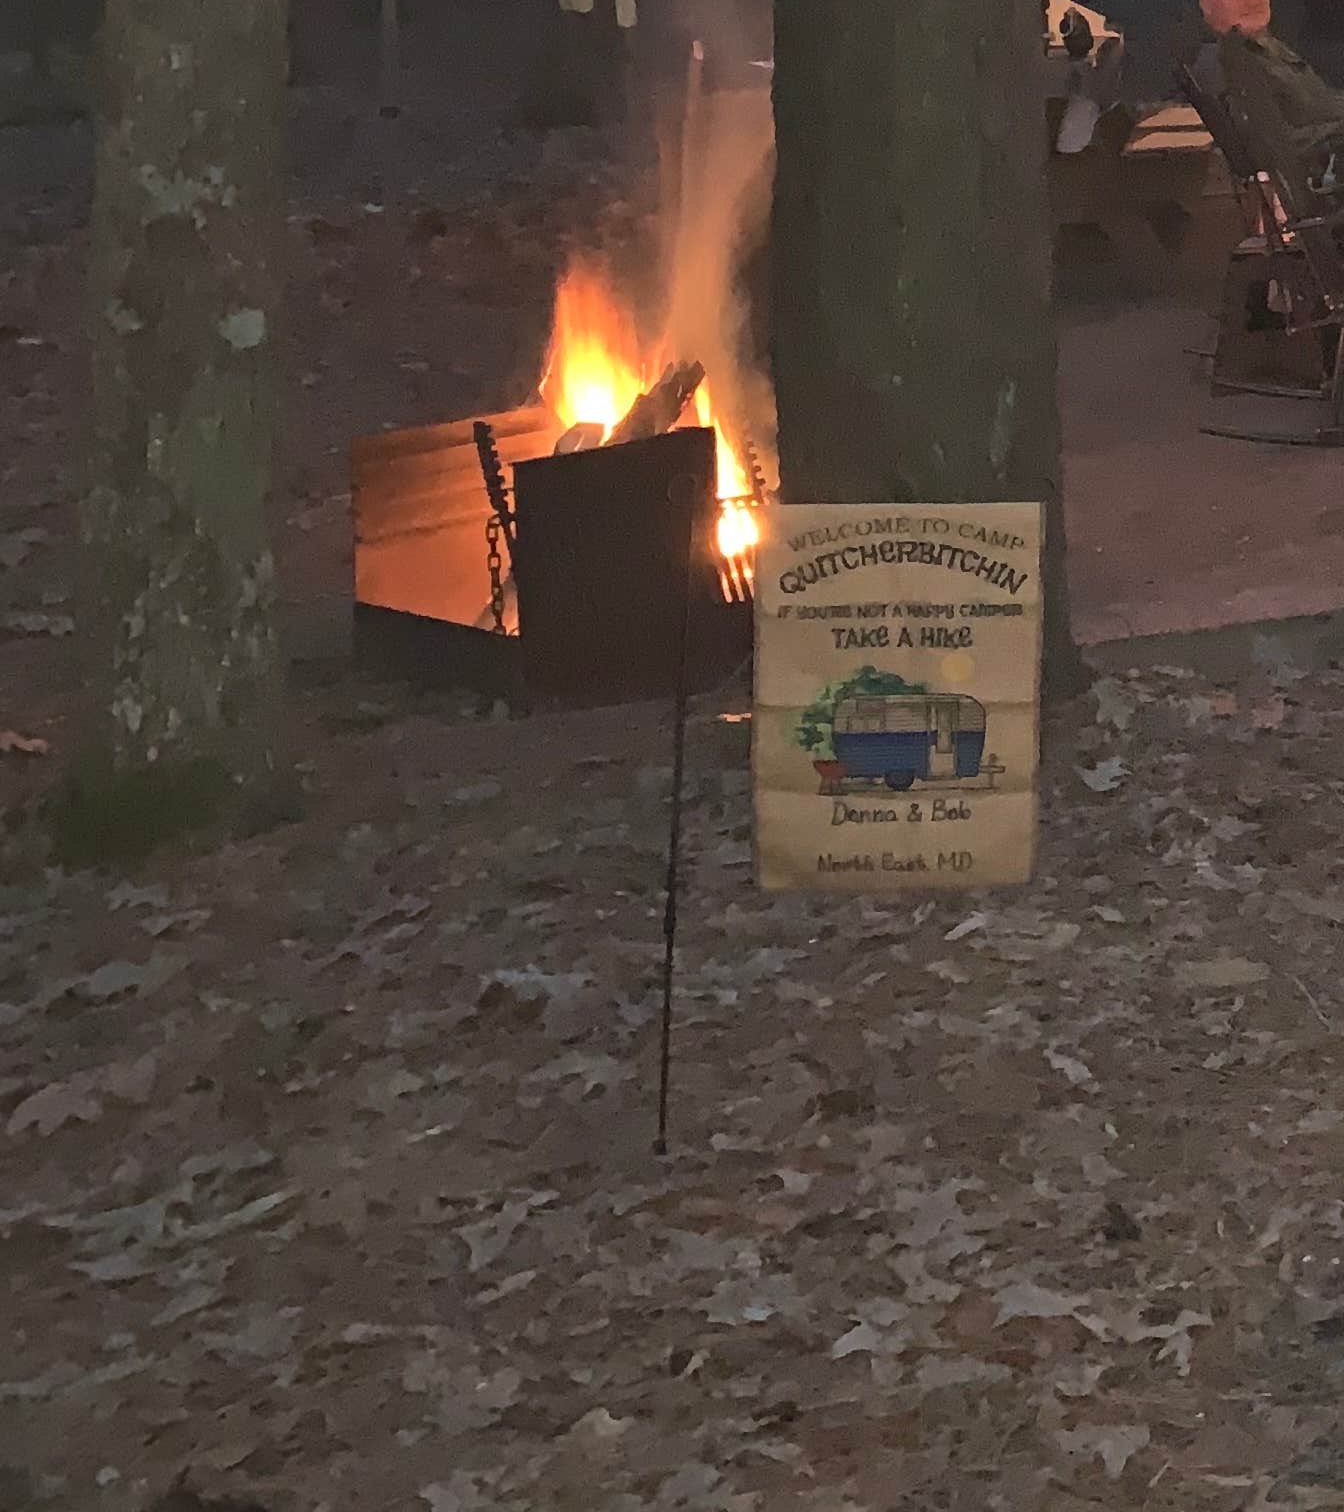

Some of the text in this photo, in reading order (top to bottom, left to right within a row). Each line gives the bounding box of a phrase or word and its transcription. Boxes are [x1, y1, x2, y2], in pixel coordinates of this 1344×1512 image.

[787, 517, 1025, 552] WELCOME TO CAMP
[777, 605, 793, 618] IF
[857, 604, 888, 619] NOT
[892, 604, 903, 618] A
[896, 627, 913, 648] A
[906, 803, 923, 822] &
[931, 798, 972, 821] Bob
[937, 851, 973, 872] MD
